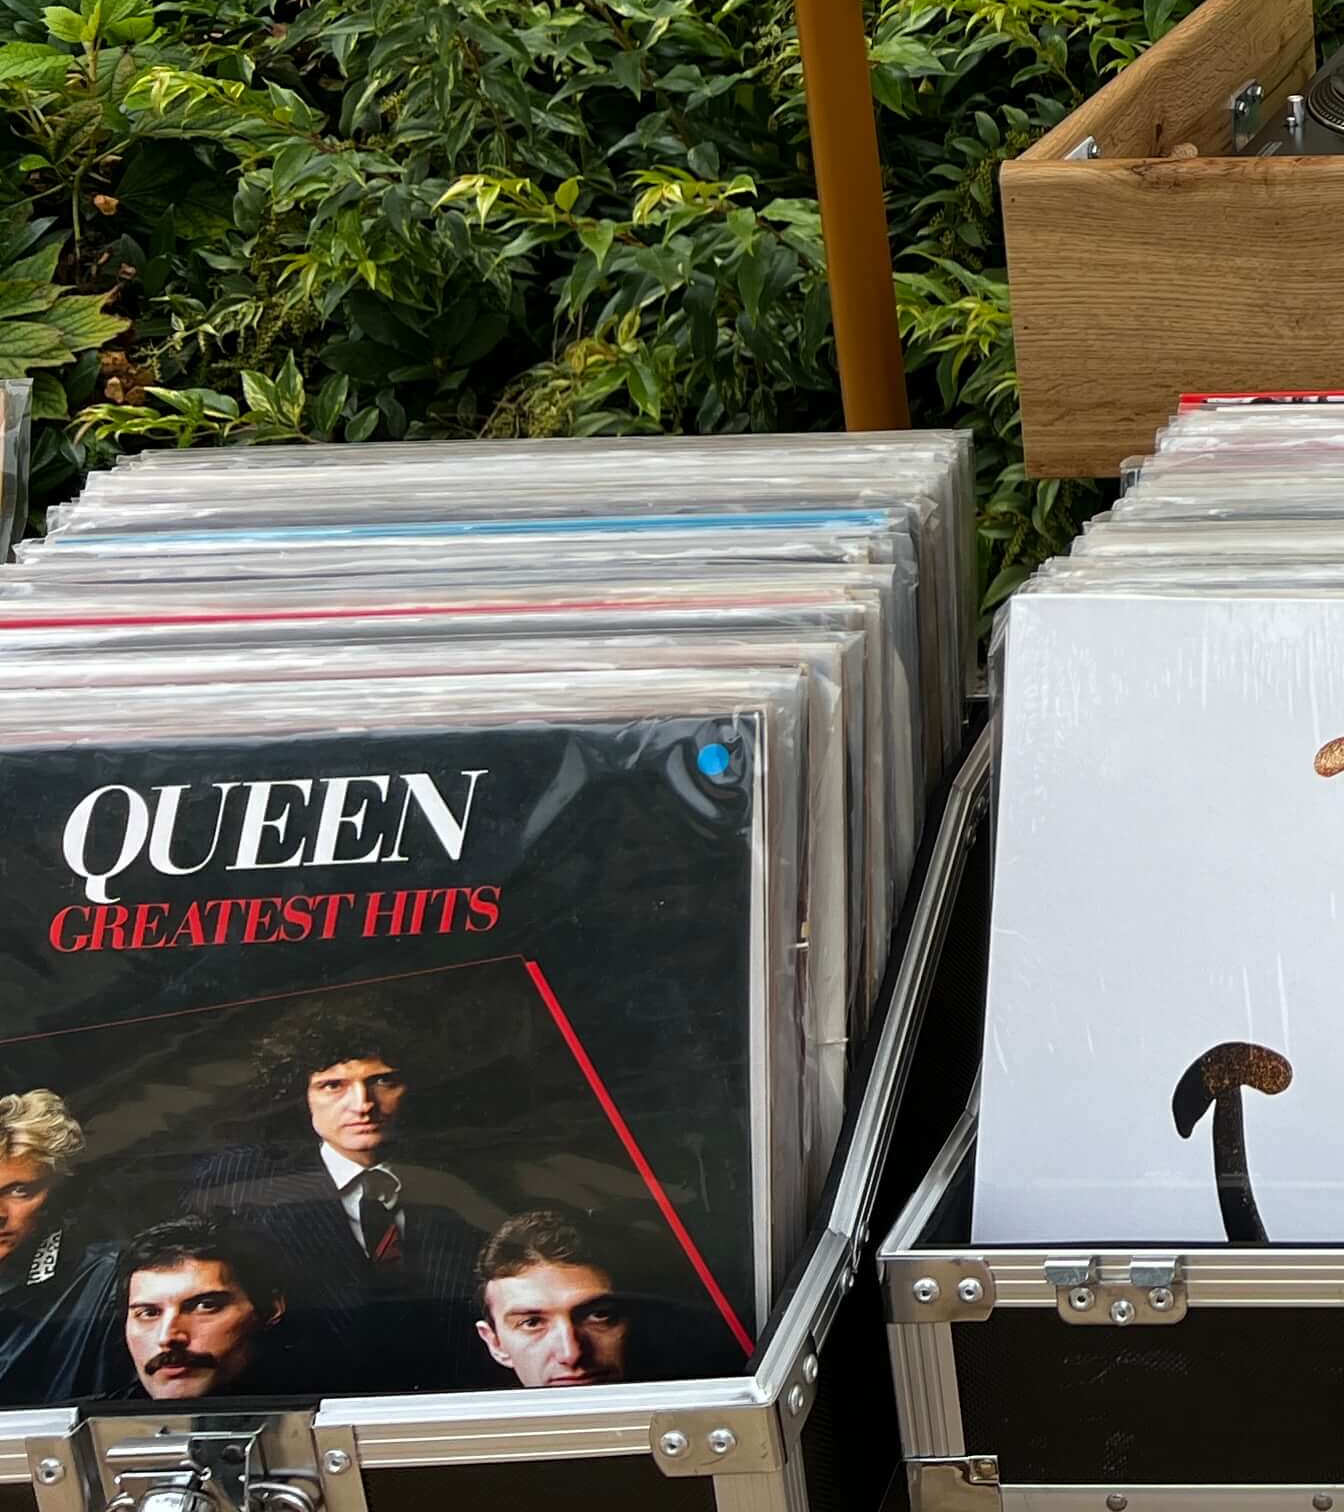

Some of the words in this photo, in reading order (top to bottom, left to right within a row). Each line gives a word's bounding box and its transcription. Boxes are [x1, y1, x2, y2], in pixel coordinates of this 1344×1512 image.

[61, 769, 489, 904] QUEEN
[48, 895, 354, 954] GREATEST
[361, 886, 503, 941] HITS
